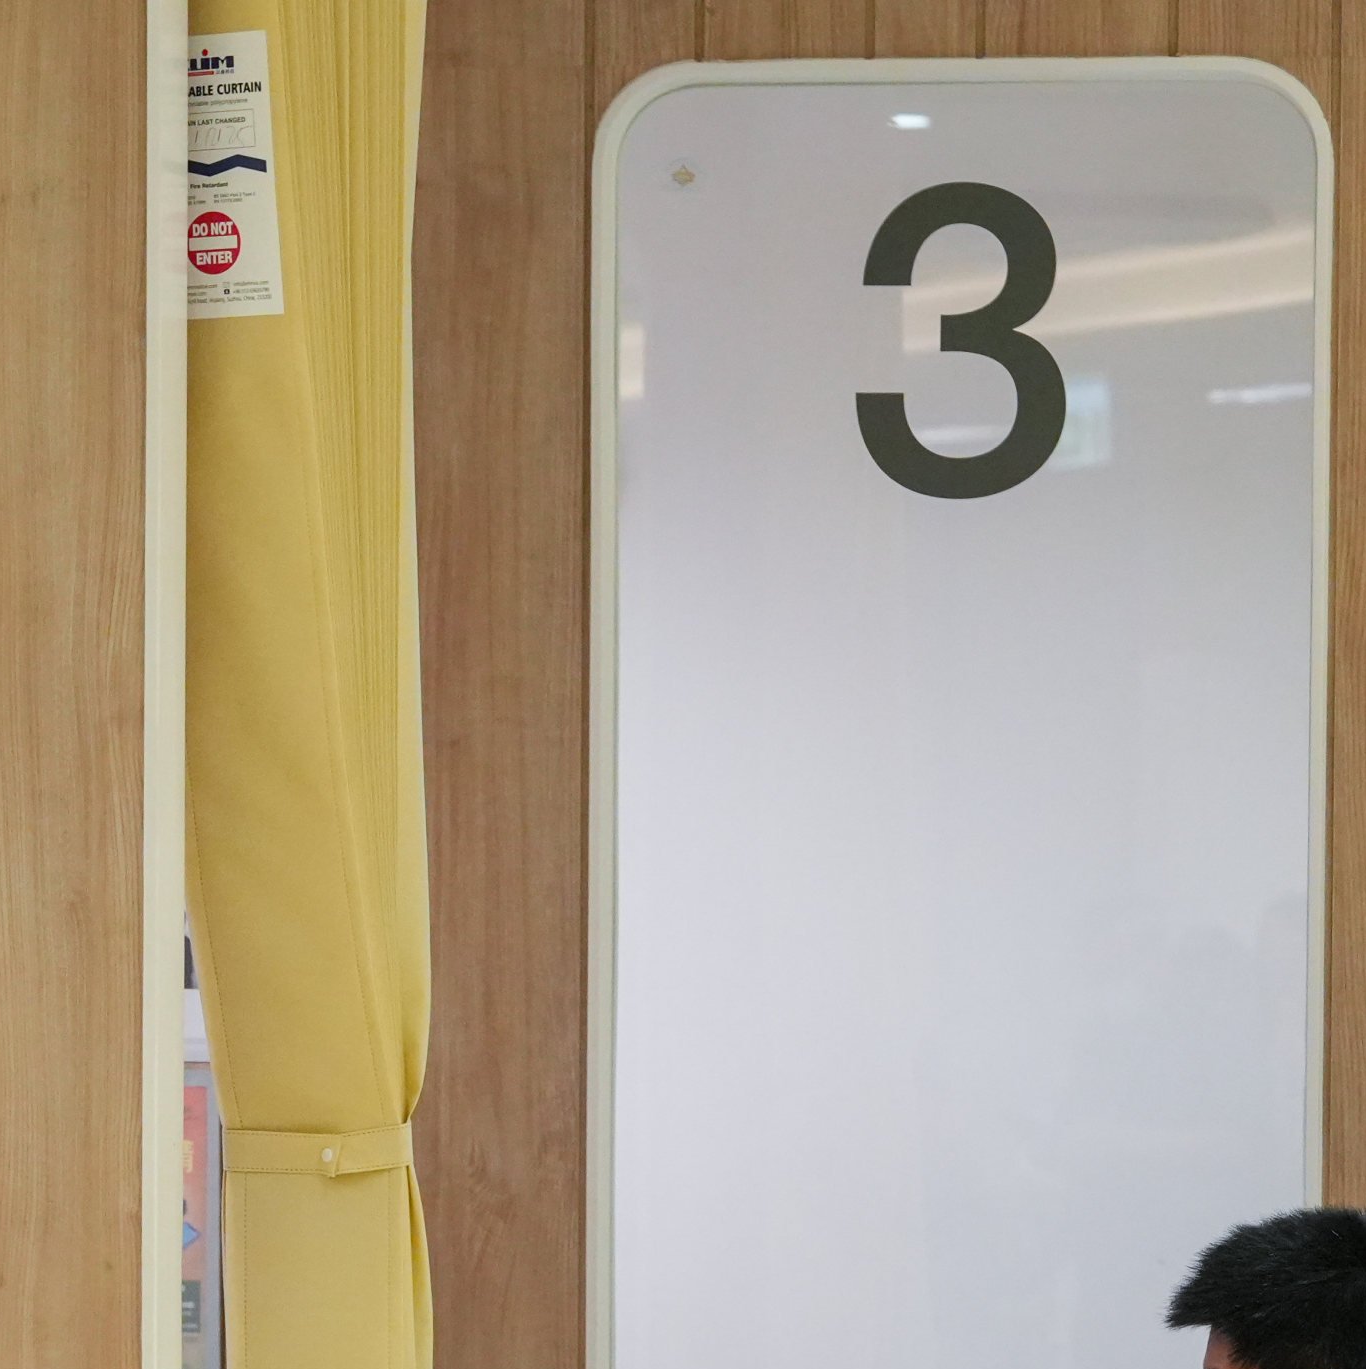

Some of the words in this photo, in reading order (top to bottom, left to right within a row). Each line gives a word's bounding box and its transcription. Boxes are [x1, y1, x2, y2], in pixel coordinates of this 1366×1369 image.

[217, 81, 262, 95] CURTAIN
[215, 116, 246, 125] CHANGED
[192, 223, 208, 236] DO
[211, 221, 233, 235] NOT
[196, 251, 233, 265] ENTER
[856, 182, 1065, 499] 3
